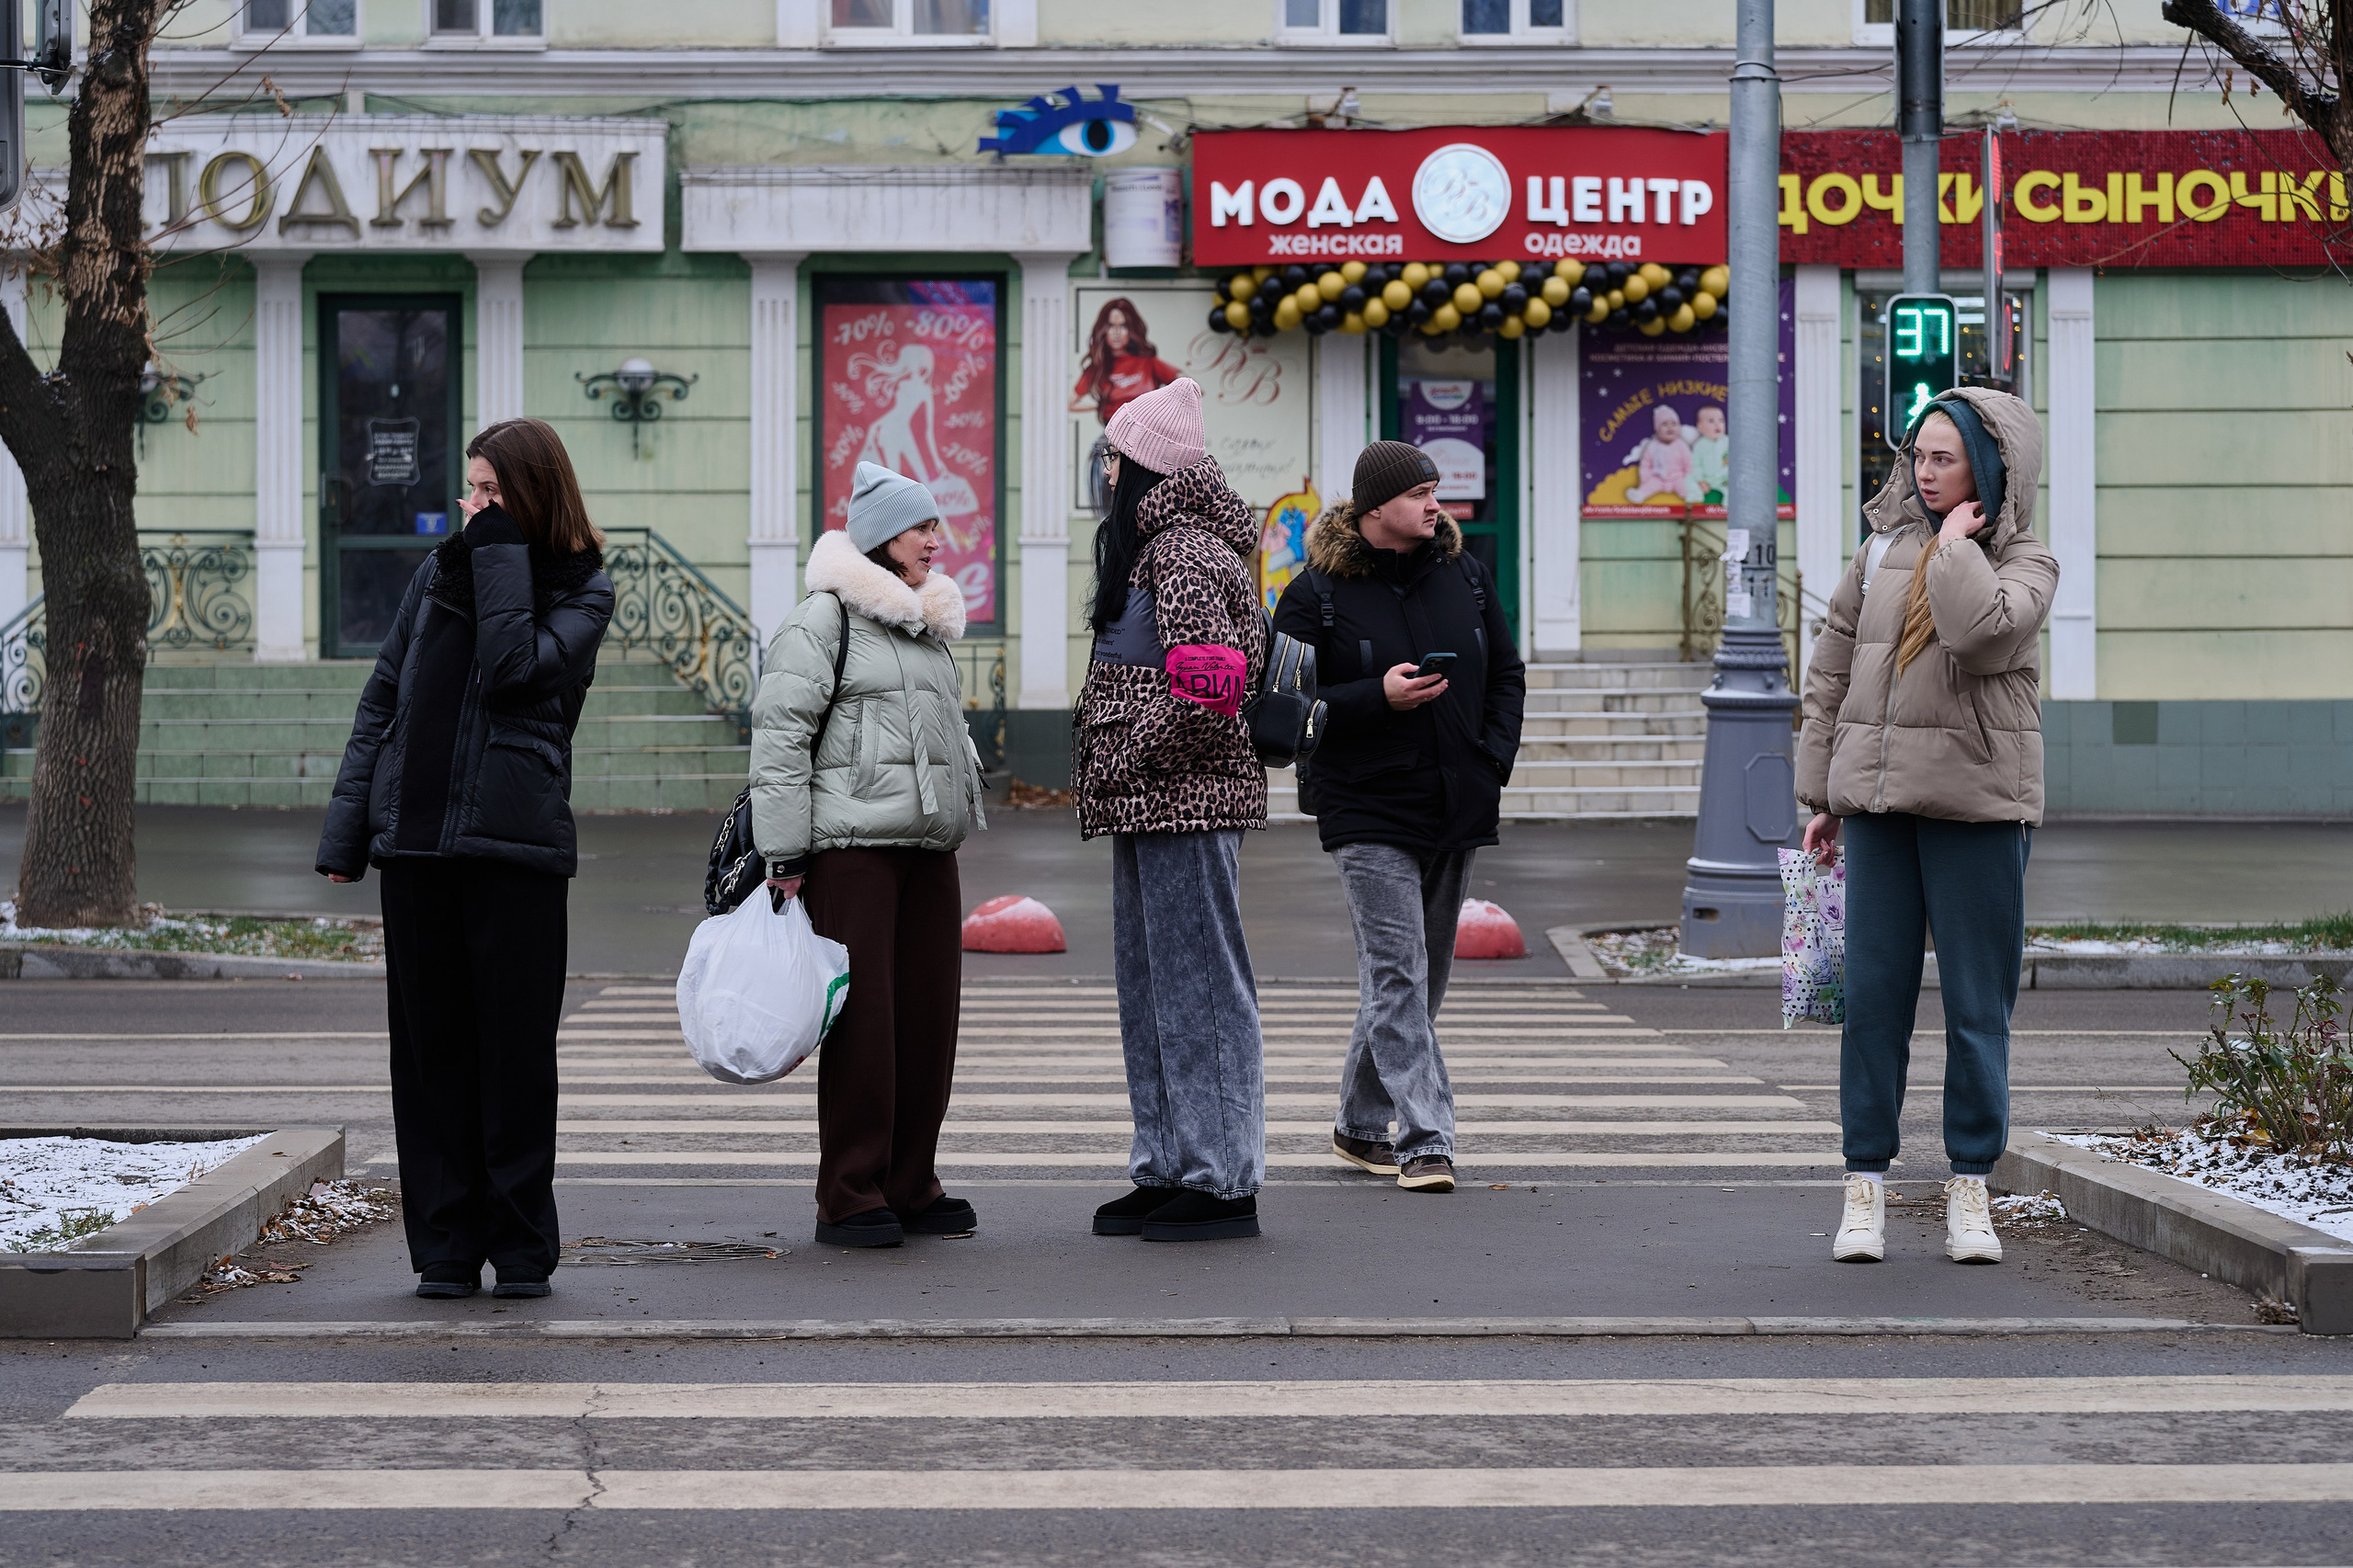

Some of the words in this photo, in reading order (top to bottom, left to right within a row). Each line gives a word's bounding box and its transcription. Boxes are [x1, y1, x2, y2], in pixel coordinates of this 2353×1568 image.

[1211, 176, 1400, 229] МОДА
[1527, 176, 1713, 227] ЦЕНТР
[1268, 233, 1404, 256] женская
[1524, 233, 1642, 258] одежда
[833, 310, 895, 346] -70%
[904, 310, 986, 351] -80%
[1896, 308, 1949, 357] 37
[1598, 387, 1654, 443] САМЫЕ
[1657, 379, 1729, 403] НИЗКИЕ
[1741, 544, 1776, 565] 10
